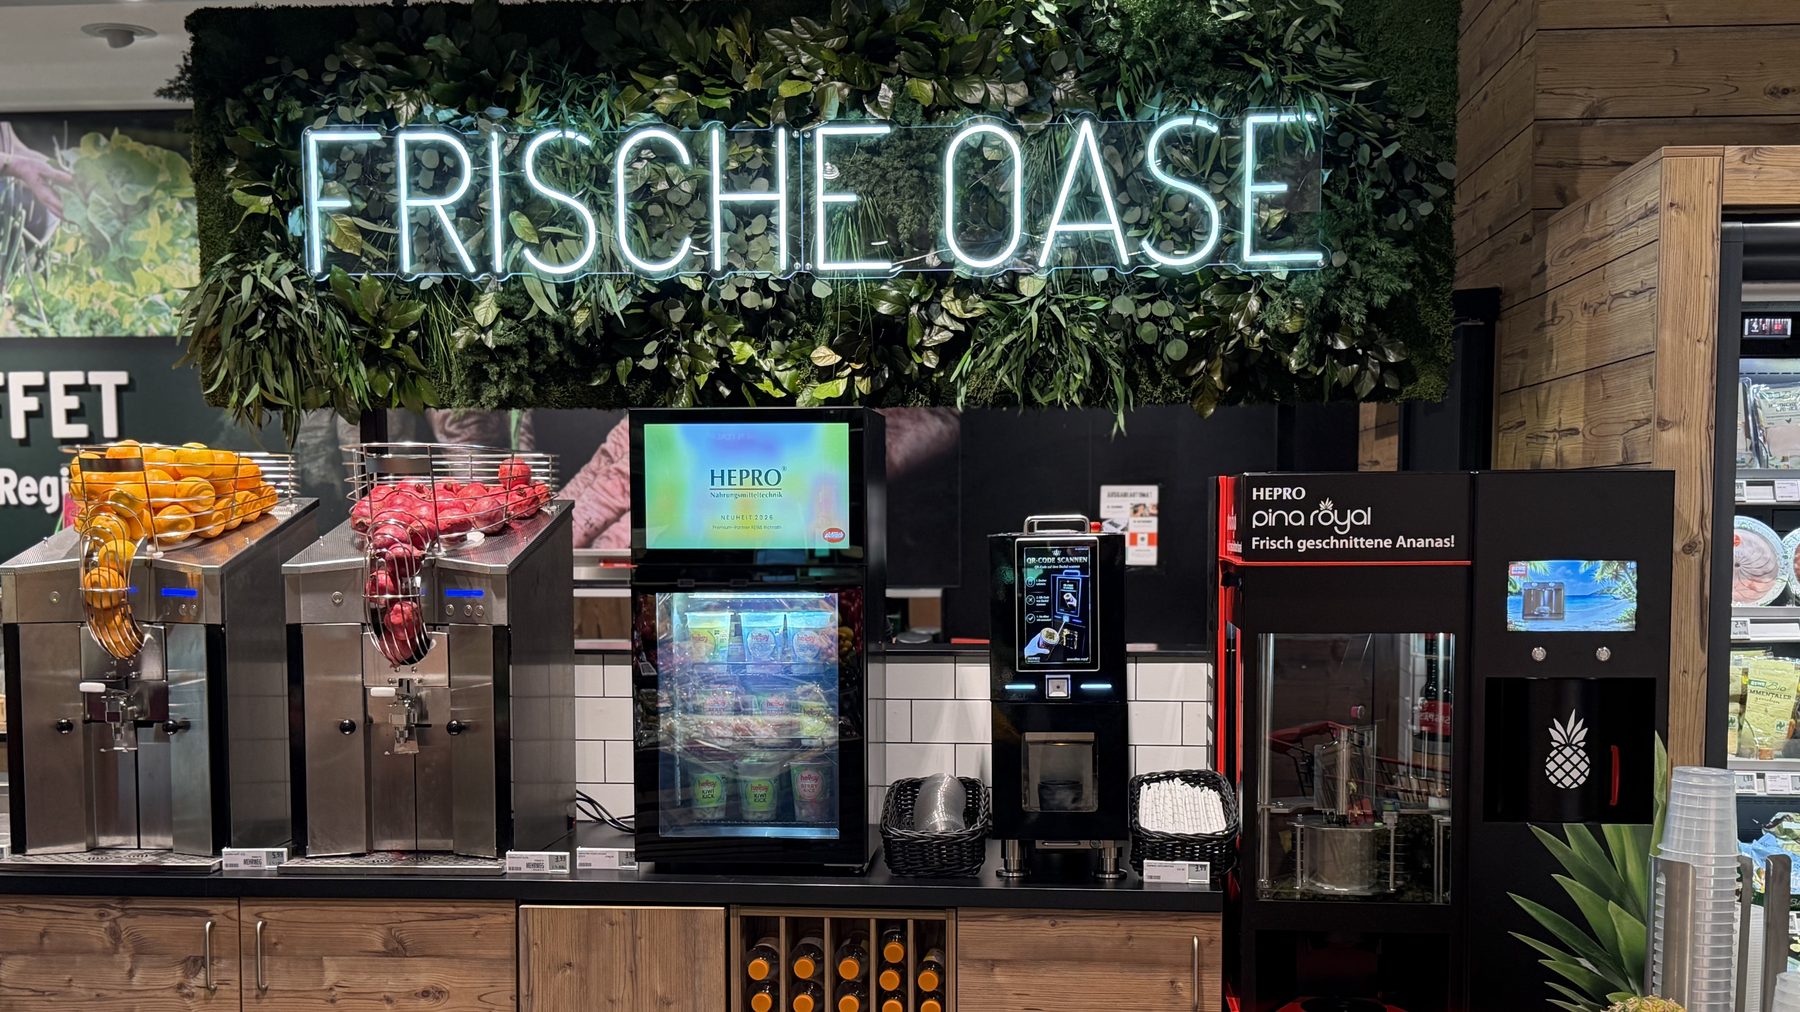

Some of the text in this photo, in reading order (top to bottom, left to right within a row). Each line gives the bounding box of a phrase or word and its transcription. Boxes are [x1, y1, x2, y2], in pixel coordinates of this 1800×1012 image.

[307, 115, 1323, 273] FRISCHE OASE
[0, 371, 129, 439] FET
[710, 468, 782, 487] HEPRO
[710, 491, 783, 499] Nahrungsmitteltechnik
[1252, 487, 1306, 500] HEPRO
[1252, 508, 1305, 529] pina
[1310, 506, 1371, 535] royal
[1251, 536, 1294, 550] Frisch
[1297, 536, 1393, 552] geschnittene
[1396, 535, 1455, 549] Ananas!
[1026, 556, 1056, 564] QR-CODE
[1749, 689, 1792, 700] MMENTALER
